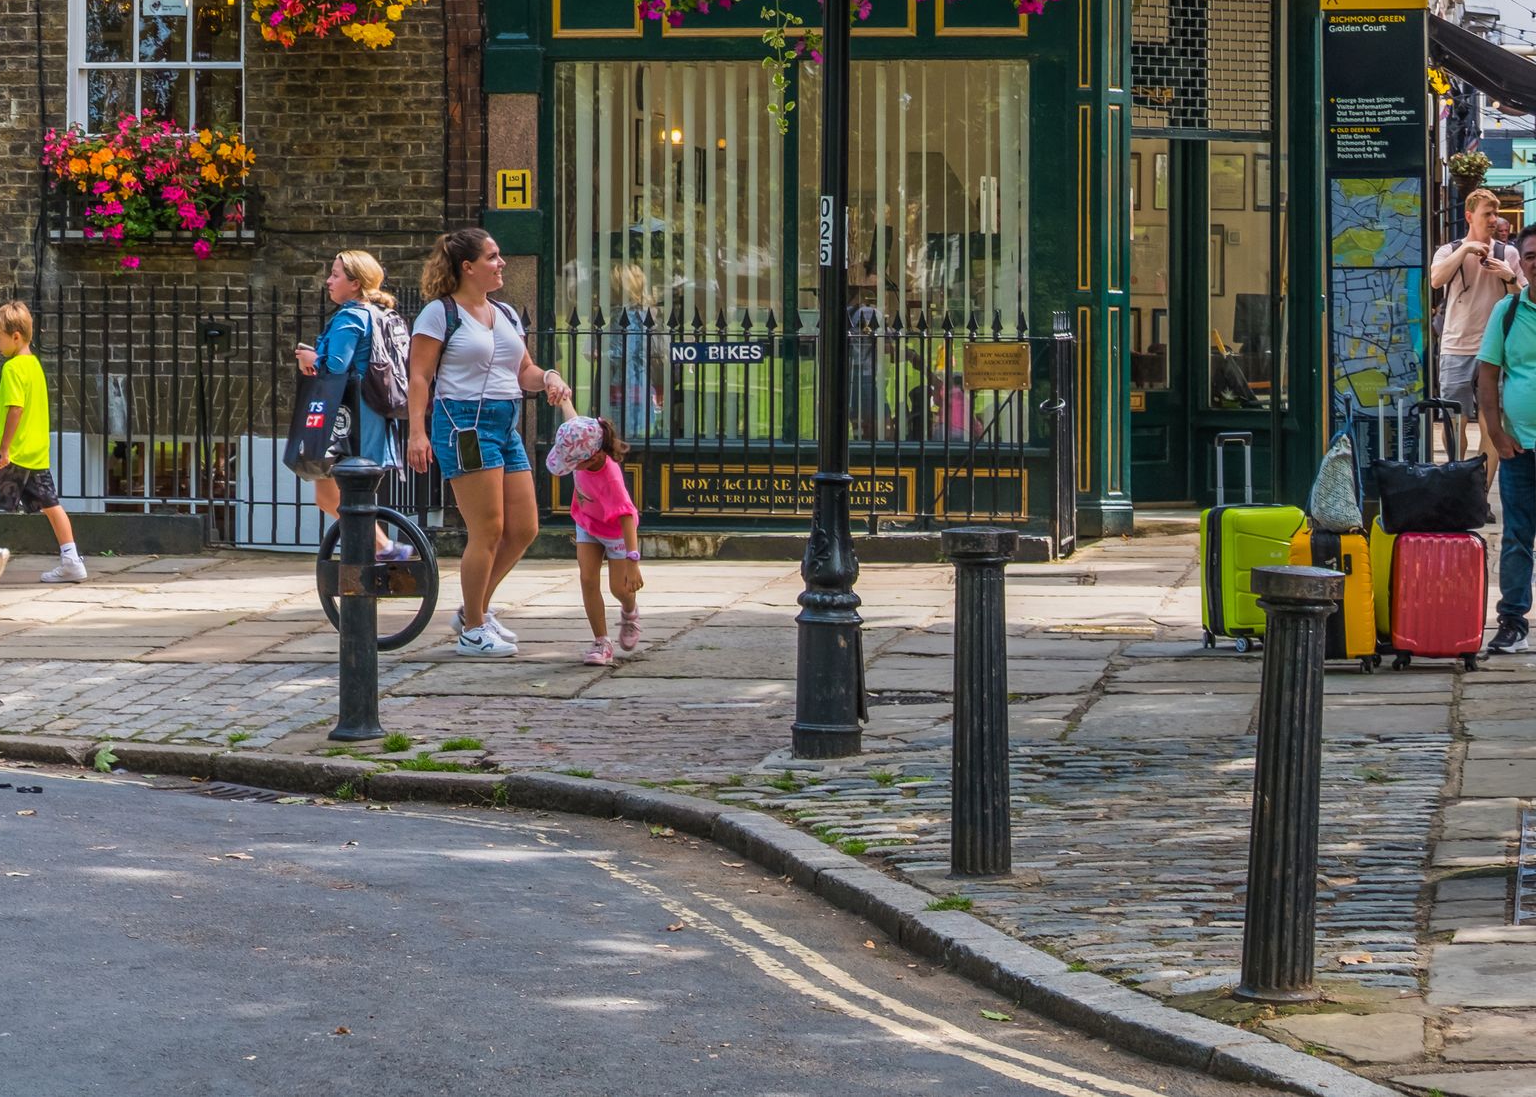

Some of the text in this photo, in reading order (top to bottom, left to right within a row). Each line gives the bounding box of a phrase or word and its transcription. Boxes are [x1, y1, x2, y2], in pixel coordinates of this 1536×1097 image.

[1330, 15, 1406, 23] RICHMOND GREEN
[1363, 24, 1387, 32] Court
[672, 345, 762, 361] NO BIKES
